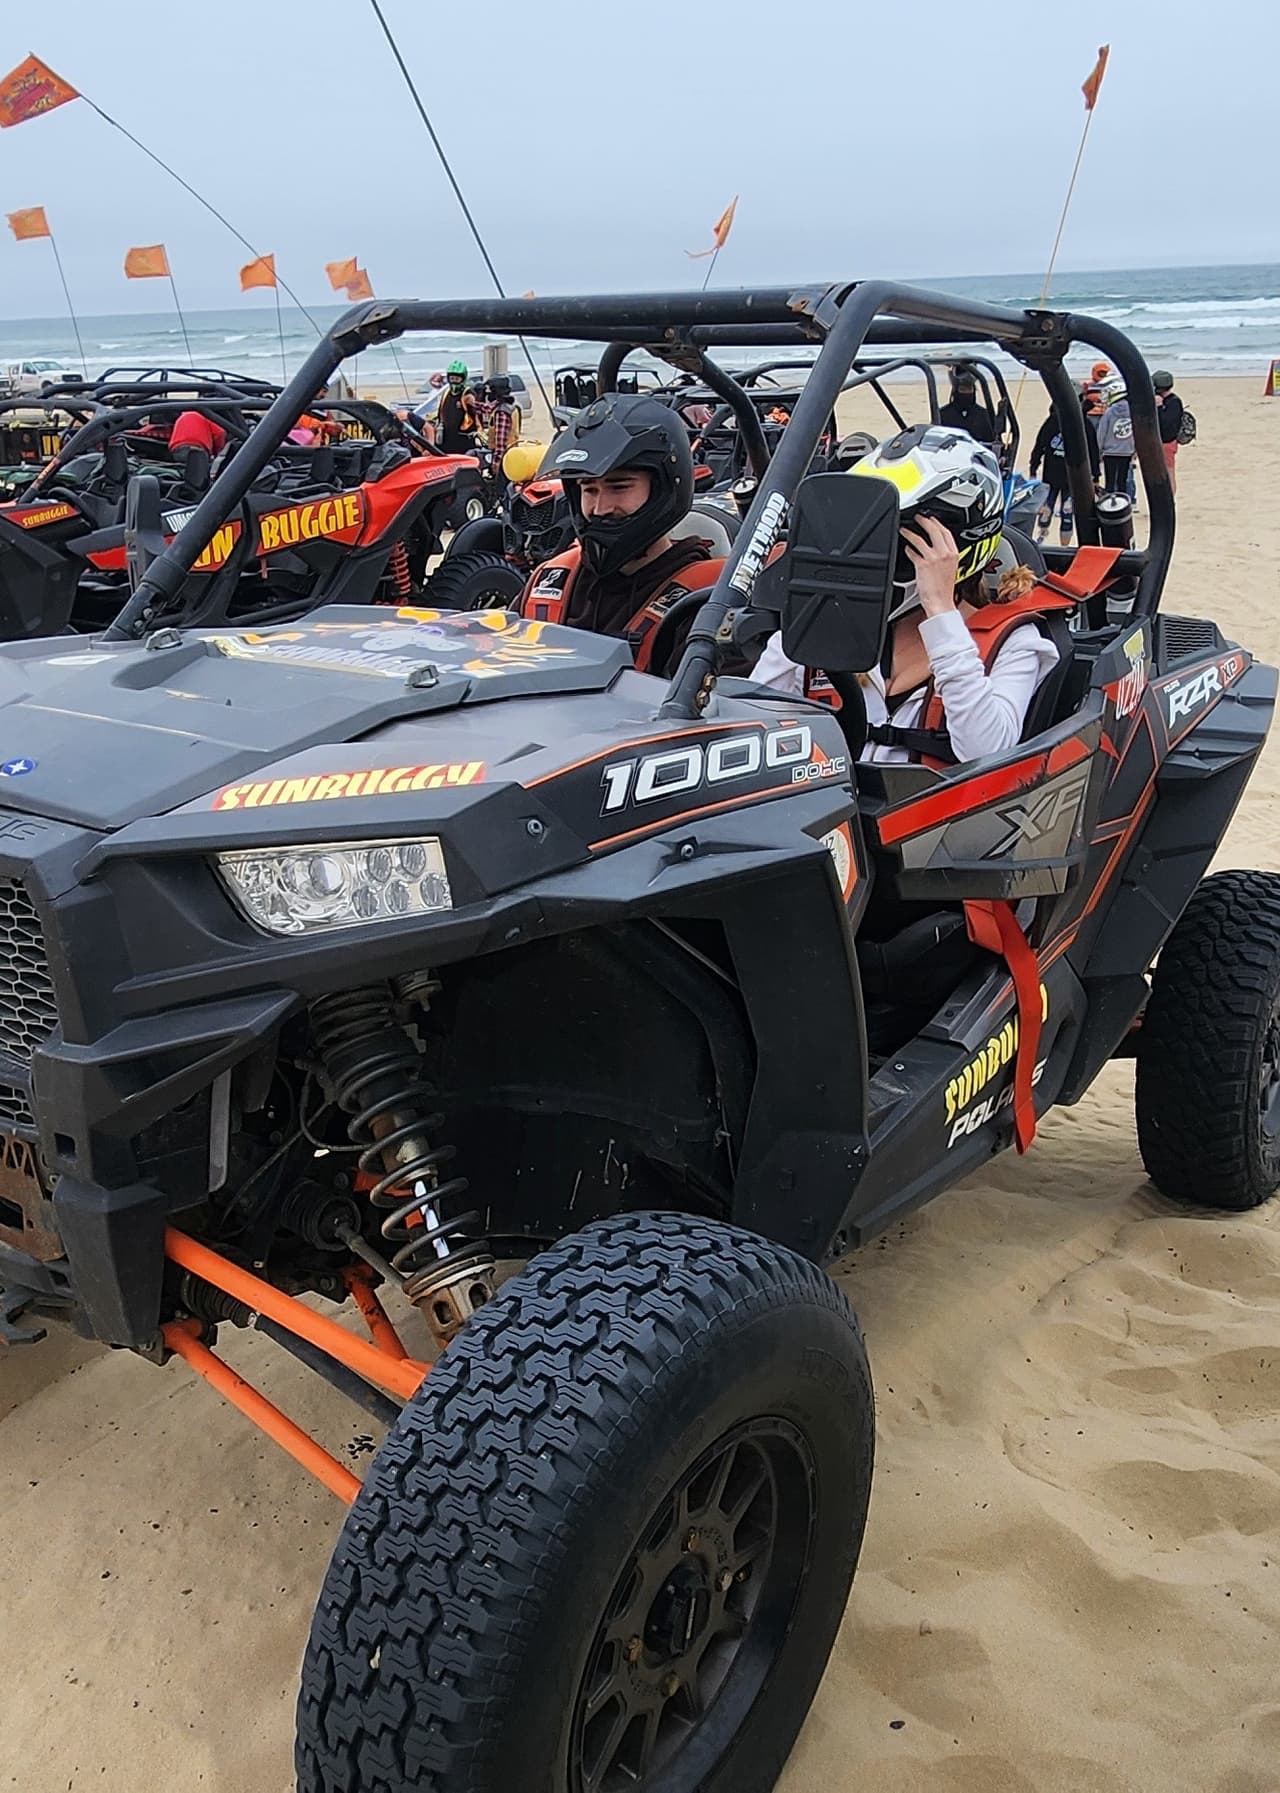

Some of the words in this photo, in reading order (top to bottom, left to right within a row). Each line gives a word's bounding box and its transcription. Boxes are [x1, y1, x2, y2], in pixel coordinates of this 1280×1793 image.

[260, 494, 362, 550] BUGGIE
[733, 491, 787, 594] METHOD
[1169, 665, 1224, 729] RZR
[1222, 656, 1238, 682] XP
[216, 760, 486, 812] SUNBUGGY
[602, 724, 814, 815] 1000
[791, 756, 846, 784] DOHC
[944, 982, 1049, 1127] SUNBU
[946, 1057, 1049, 1149] POLAS
